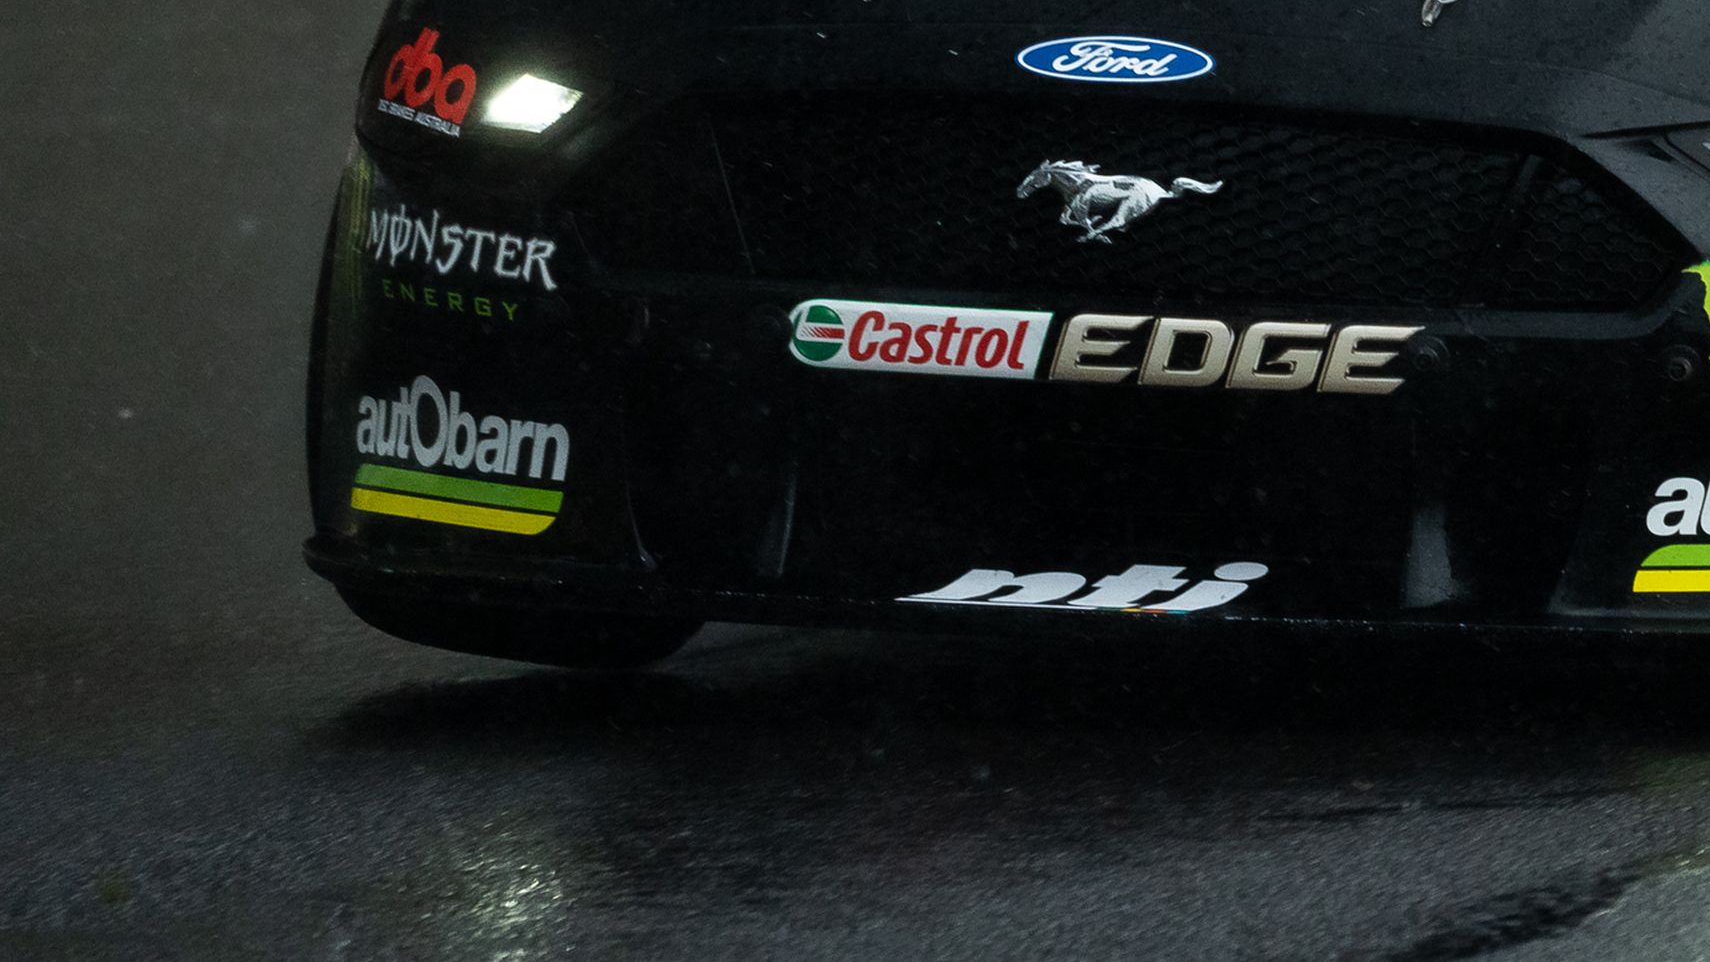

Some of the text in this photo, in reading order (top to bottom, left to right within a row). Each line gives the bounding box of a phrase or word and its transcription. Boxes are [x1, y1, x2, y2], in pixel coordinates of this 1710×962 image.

[384, 27, 477, 125] dba
[1051, 40, 1178, 79] Ford
[382, 279, 520, 322] ENERGY
[847, 310, 1029, 370] Castrol
[1048, 313, 1427, 394] EDGE
